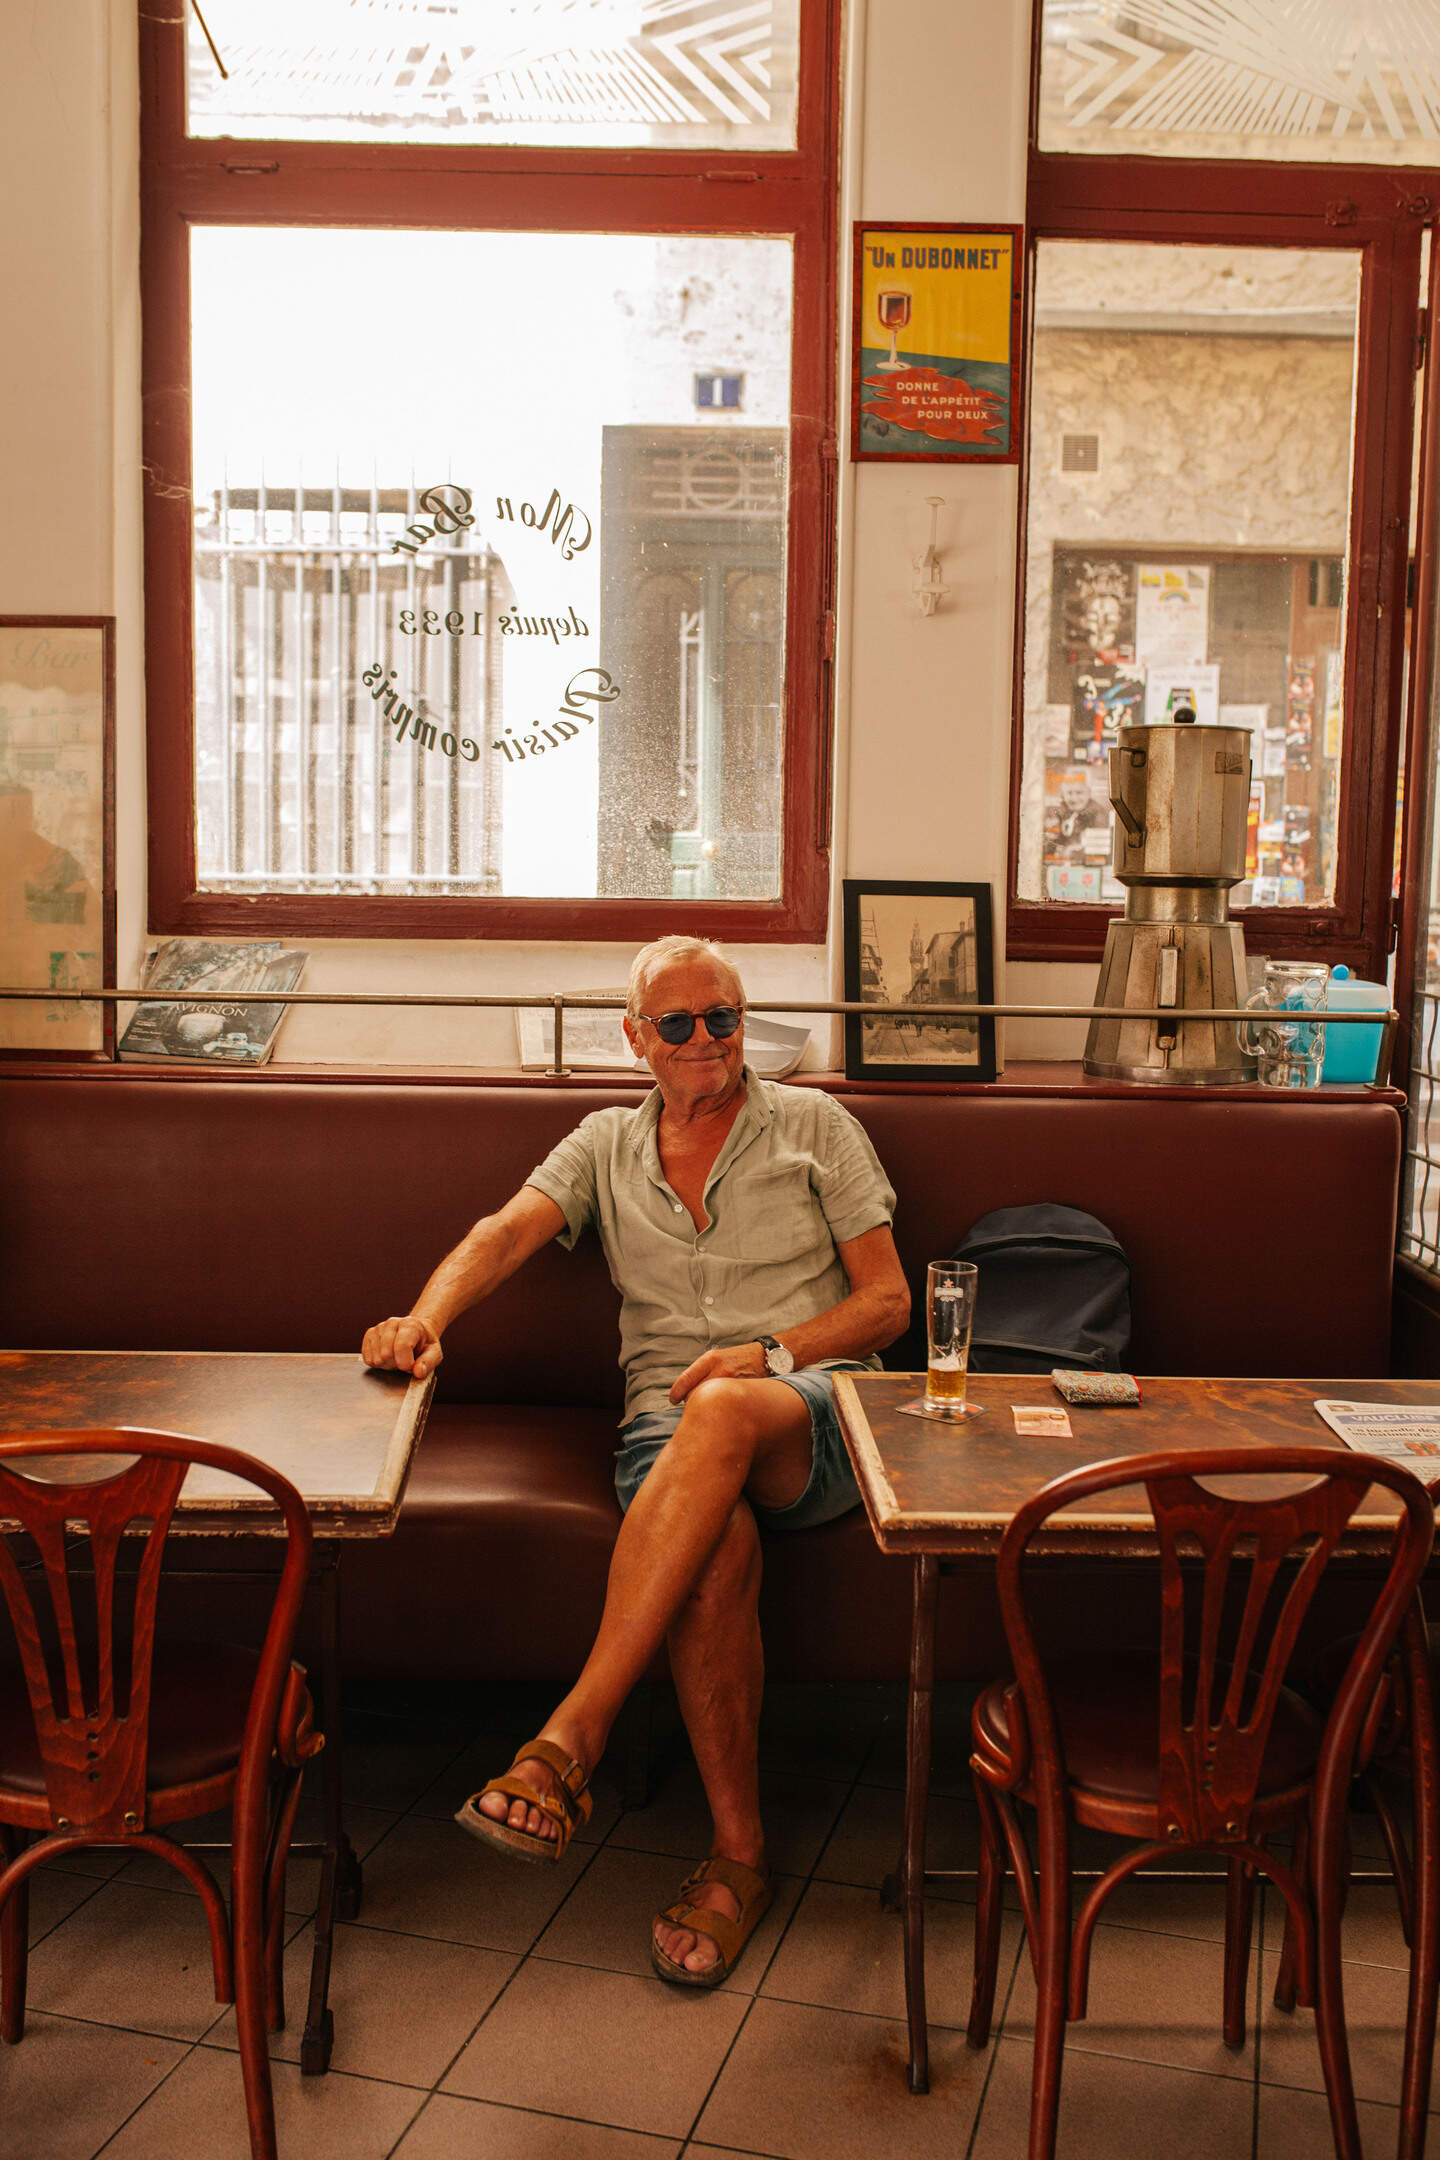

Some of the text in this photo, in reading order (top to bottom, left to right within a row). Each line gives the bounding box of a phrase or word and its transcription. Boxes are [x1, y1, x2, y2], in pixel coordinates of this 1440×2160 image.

[896, 382, 939, 392] DONNE
[902, 393, 981, 406] DE L'APPÉTIT
[917, 410, 988, 420] POUR DEUX
